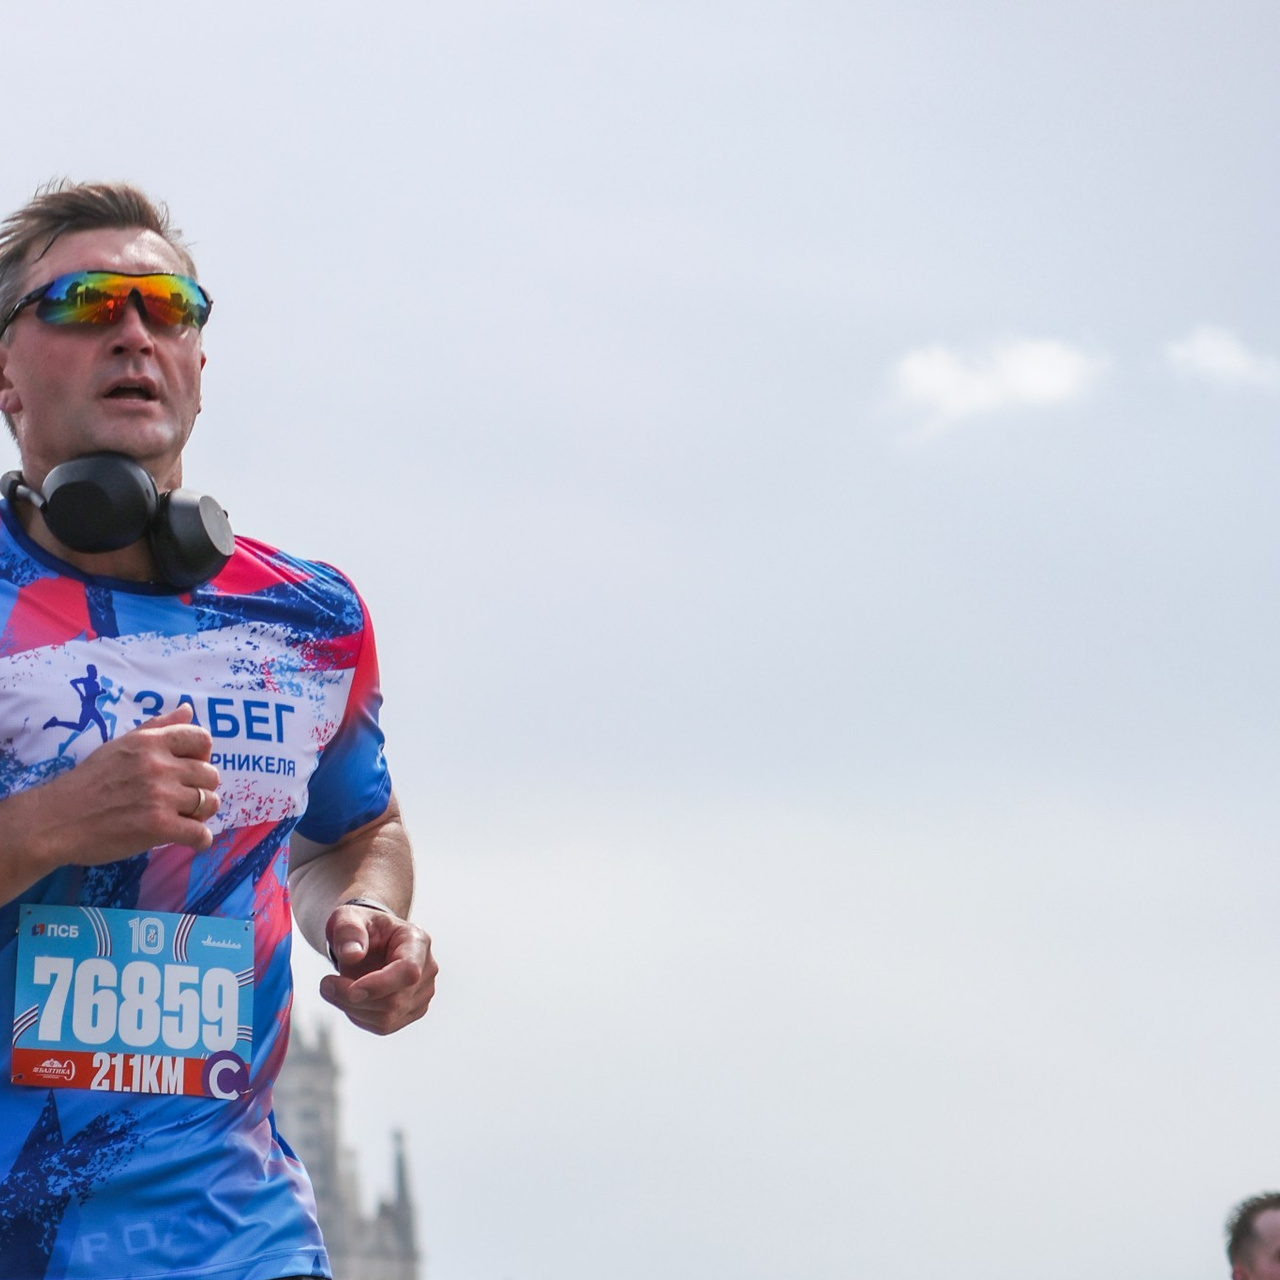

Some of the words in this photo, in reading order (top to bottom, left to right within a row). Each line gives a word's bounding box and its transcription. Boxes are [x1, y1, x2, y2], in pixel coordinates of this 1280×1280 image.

[210, 753, 296, 777] РНИКЕЛЯ
[46, 923, 79, 938] ПСБ
[33, 956, 239, 1052] 76859
[90, 1052, 185, 1095] 21.1KM
[208, 1059, 241, 1100] C
